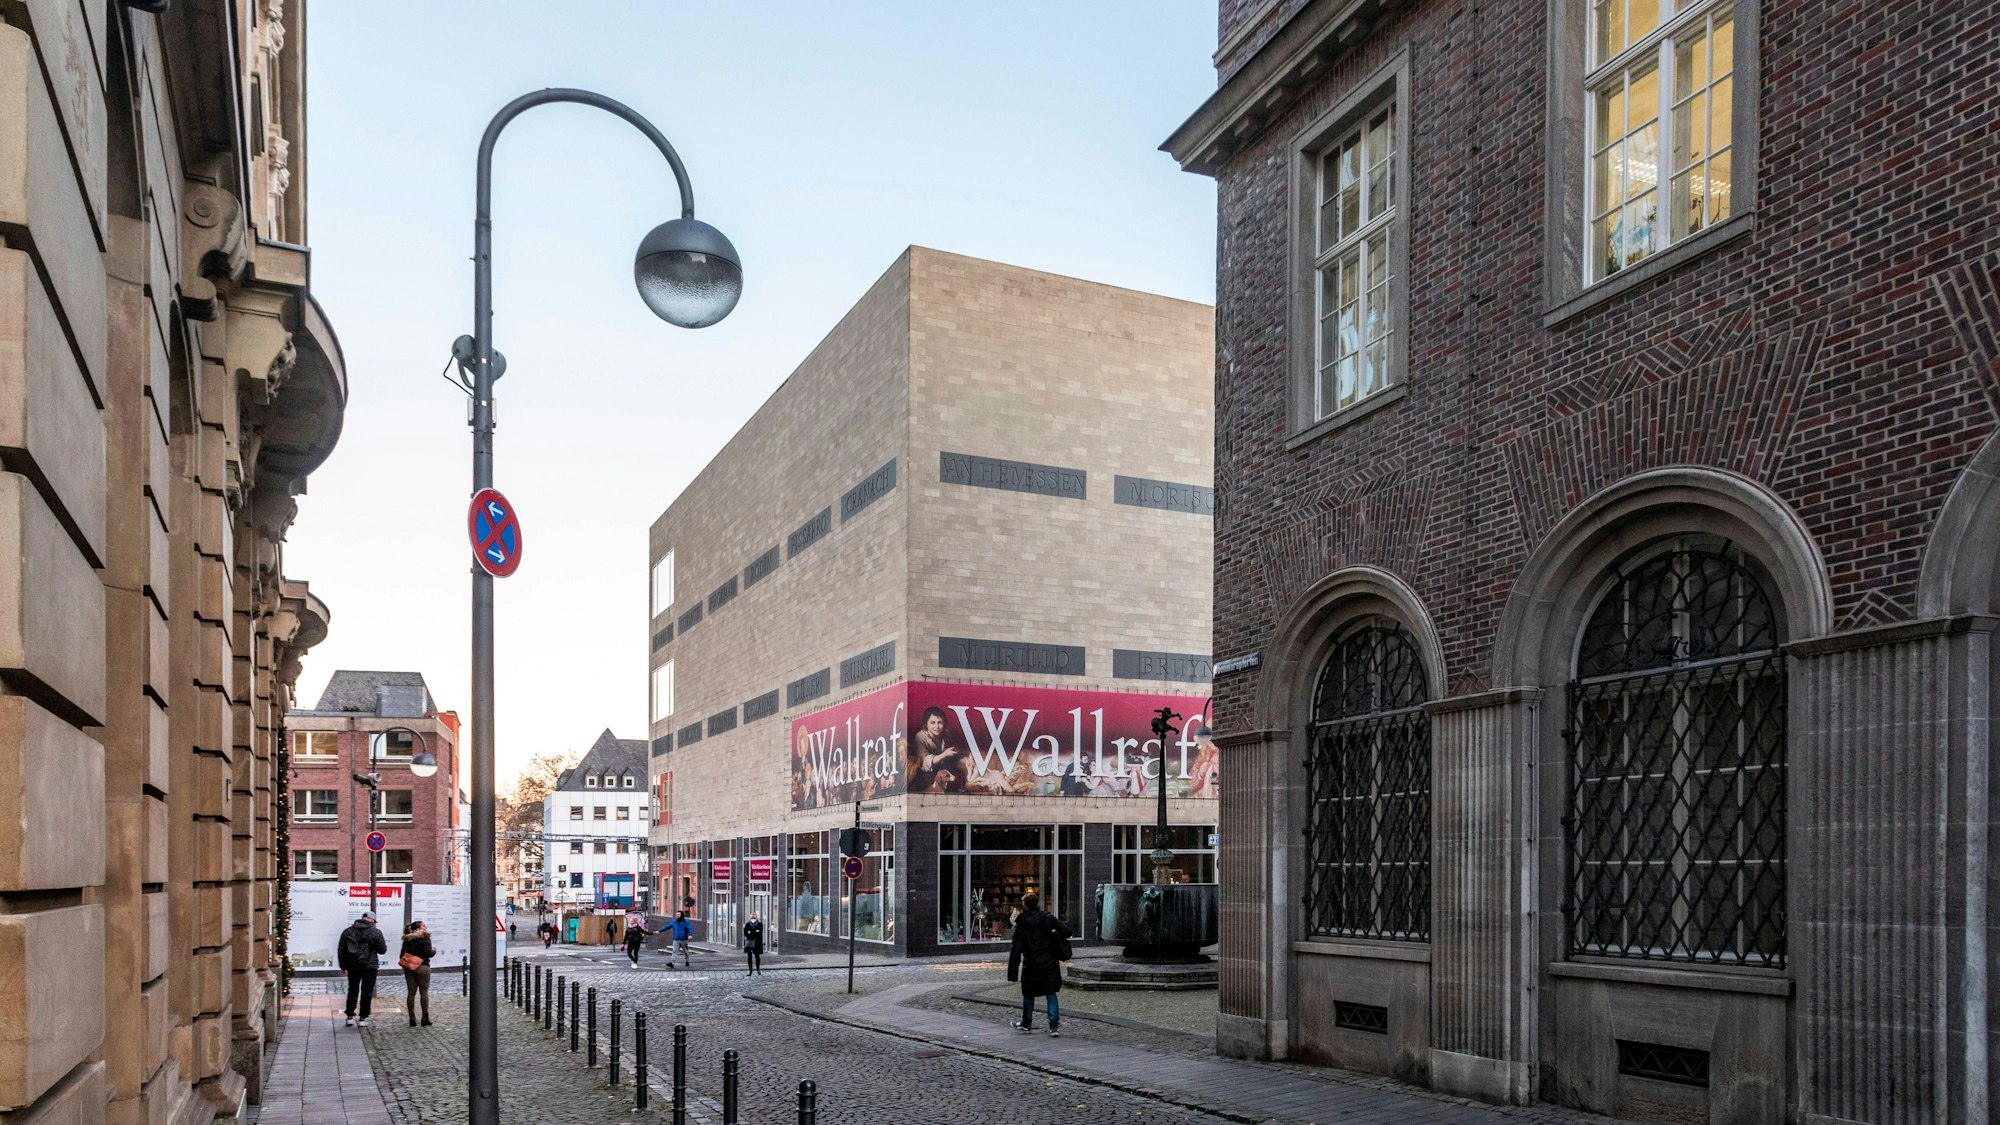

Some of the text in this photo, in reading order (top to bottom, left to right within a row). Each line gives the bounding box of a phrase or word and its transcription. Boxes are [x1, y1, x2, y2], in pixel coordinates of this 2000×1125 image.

[846, 468, 890, 513] CRANACH
[942, 457, 1086, 493] VAN HEMESSEN
[790, 515, 827, 554] PISSARRO
[844, 648, 891, 683] RUISDAEL
[957, 642, 1070, 669] MURILLO
[807, 702, 904, 791] Wallraf
[948, 705, 1203, 779] Wallraf
